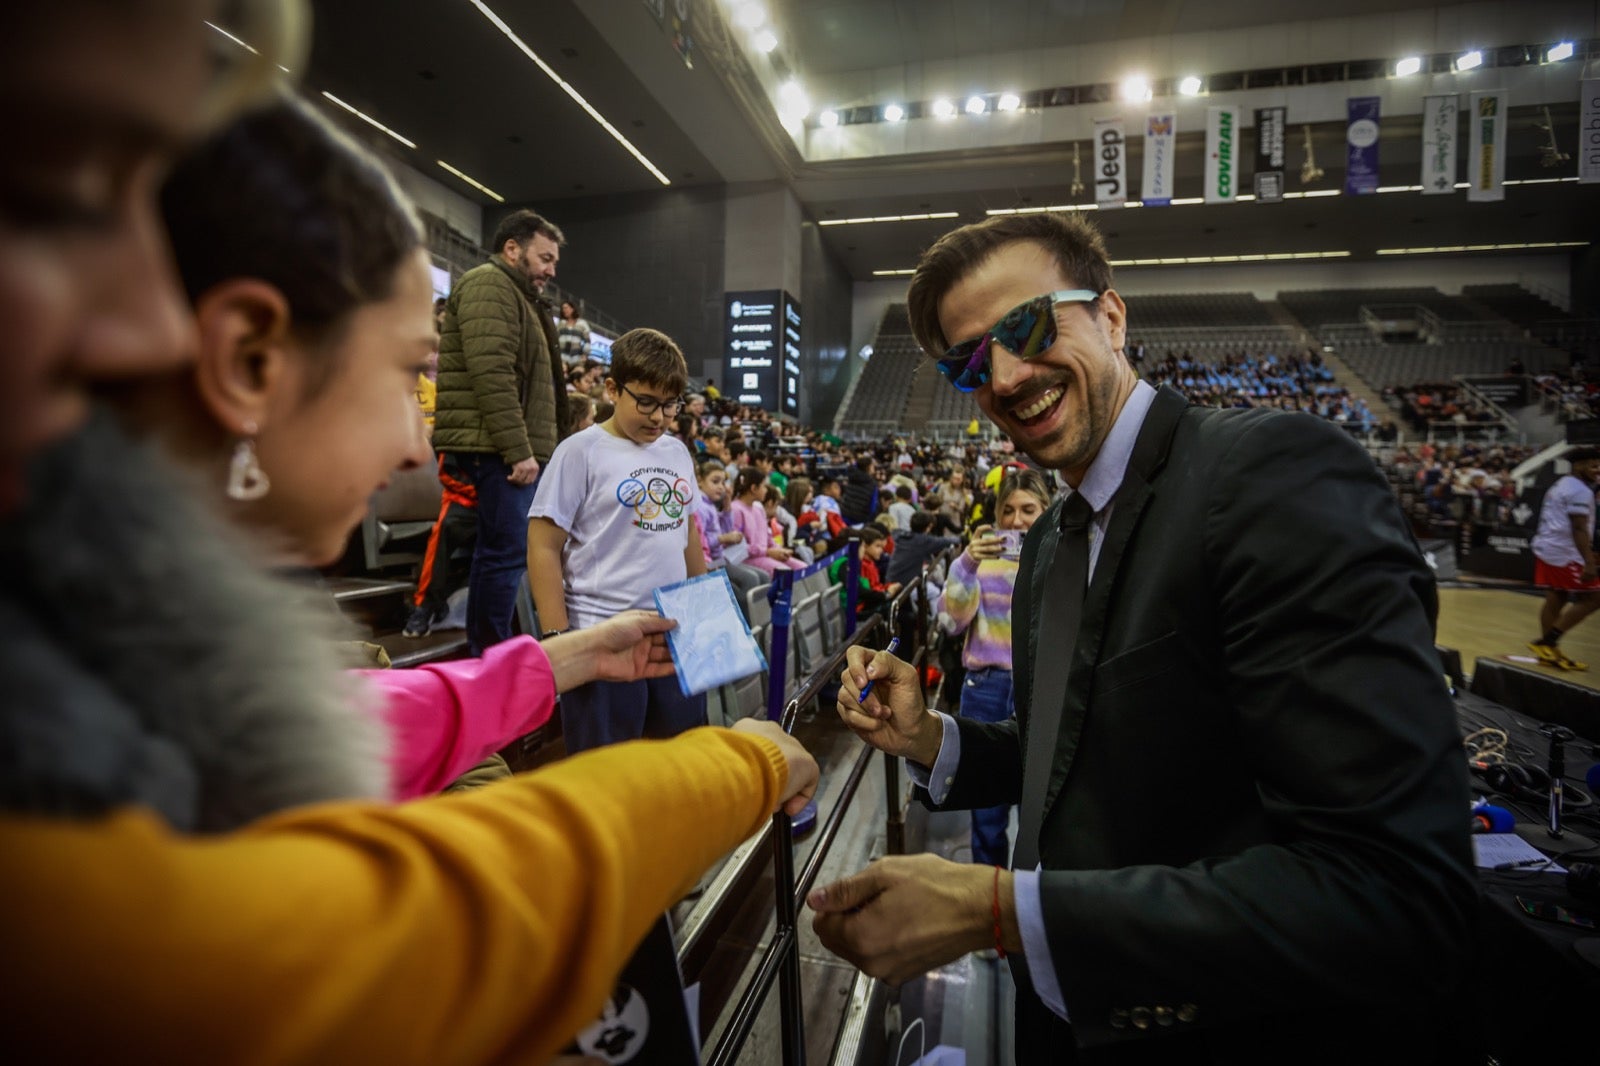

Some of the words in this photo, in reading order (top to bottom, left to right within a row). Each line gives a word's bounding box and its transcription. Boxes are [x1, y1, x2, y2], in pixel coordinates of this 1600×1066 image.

[1096, 128, 1124, 196] Jeep
[629, 467, 680, 479] CONVIVENCIA
[642, 520, 681, 533] OLIMPICA
